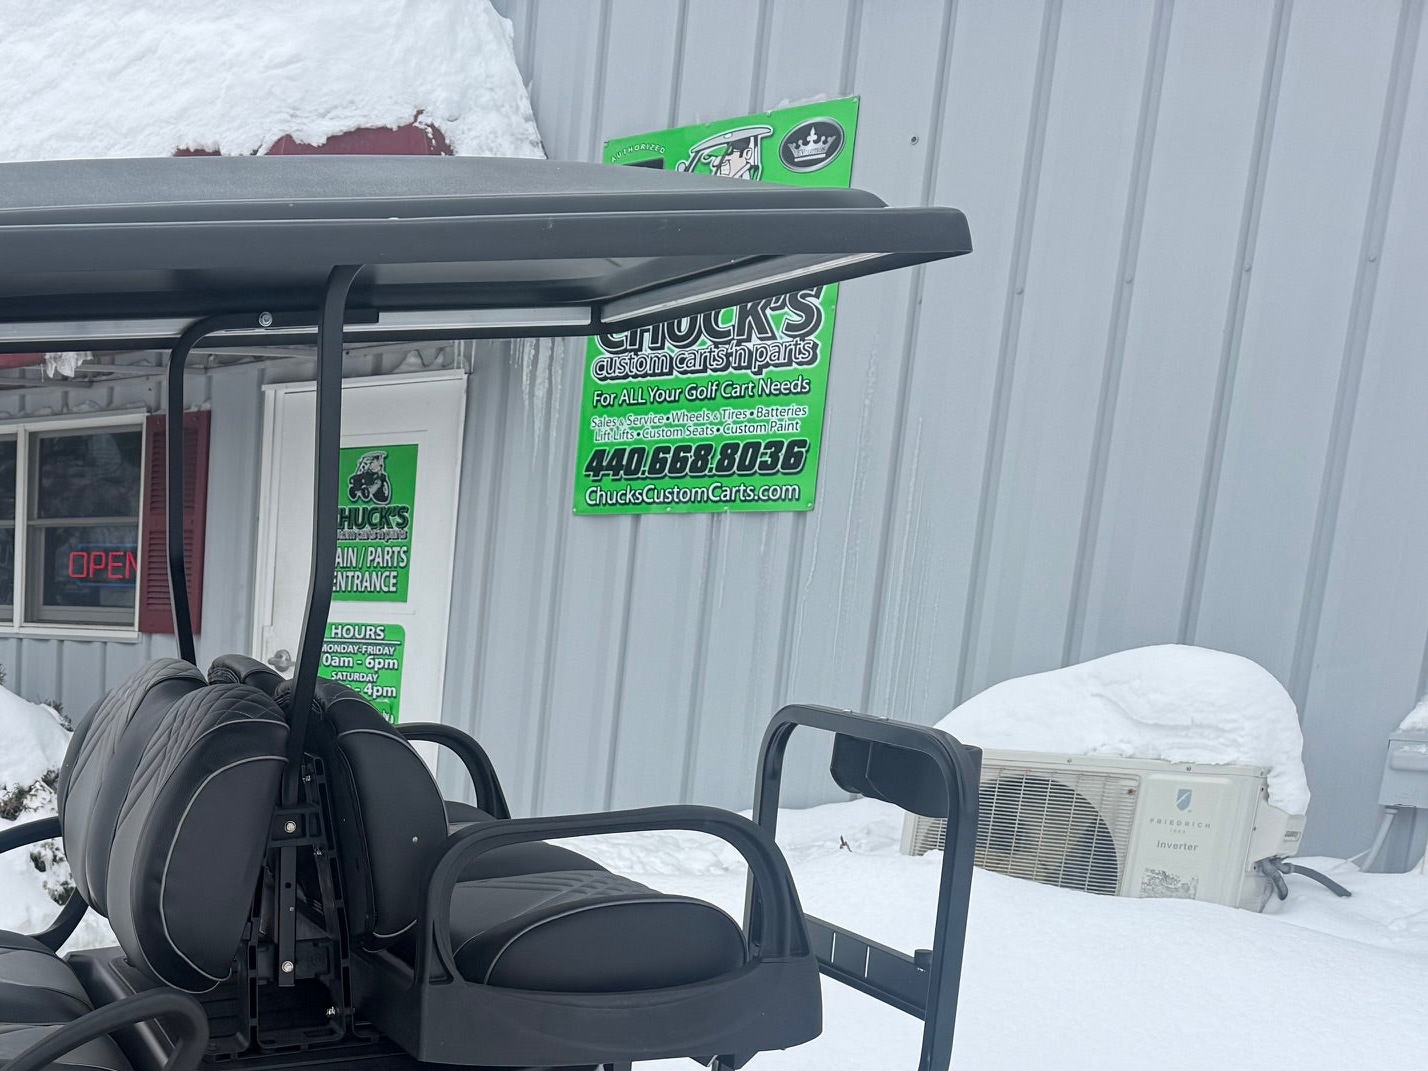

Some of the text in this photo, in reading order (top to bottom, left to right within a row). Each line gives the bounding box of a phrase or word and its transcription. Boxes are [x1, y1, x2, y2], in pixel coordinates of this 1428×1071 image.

[611, 143, 666, 163] AUTHORIZED
[593, 351, 669, 375] custom
[752, 338, 813, 370] parts
[593, 376, 810, 406] For ALL Your Golf Cart Needs
[592, 416, 617, 428] Sales
[626, 413, 665, 426] Service
[671, 410, 711, 424] Wheels
[721, 408, 748, 421] Tires
[756, 404, 807, 419] Batteries
[594, 420, 801, 442] Lift Lifts Custom Seats Custom Paint
[584, 439, 809, 480] 440.668.8036
[585, 483, 801, 506] ChucksCustomCarts.com
[338, 506, 410, 530] HUCK'S
[68, 551, 138, 579] OPEN
[335, 547, 357, 568] AIN
[367, 546, 408, 568] PARTS
[332, 625, 385, 640] HOURS
[322, 653, 353, 667] 0am
[365, 656, 398, 671] 6pm
[331, 671, 379, 682] SATURDAY
[363, 683, 397, 699] 4pm
[1149, 818, 1212, 829] FRIEDRICH
[1156, 840, 1199, 851] Inverter
